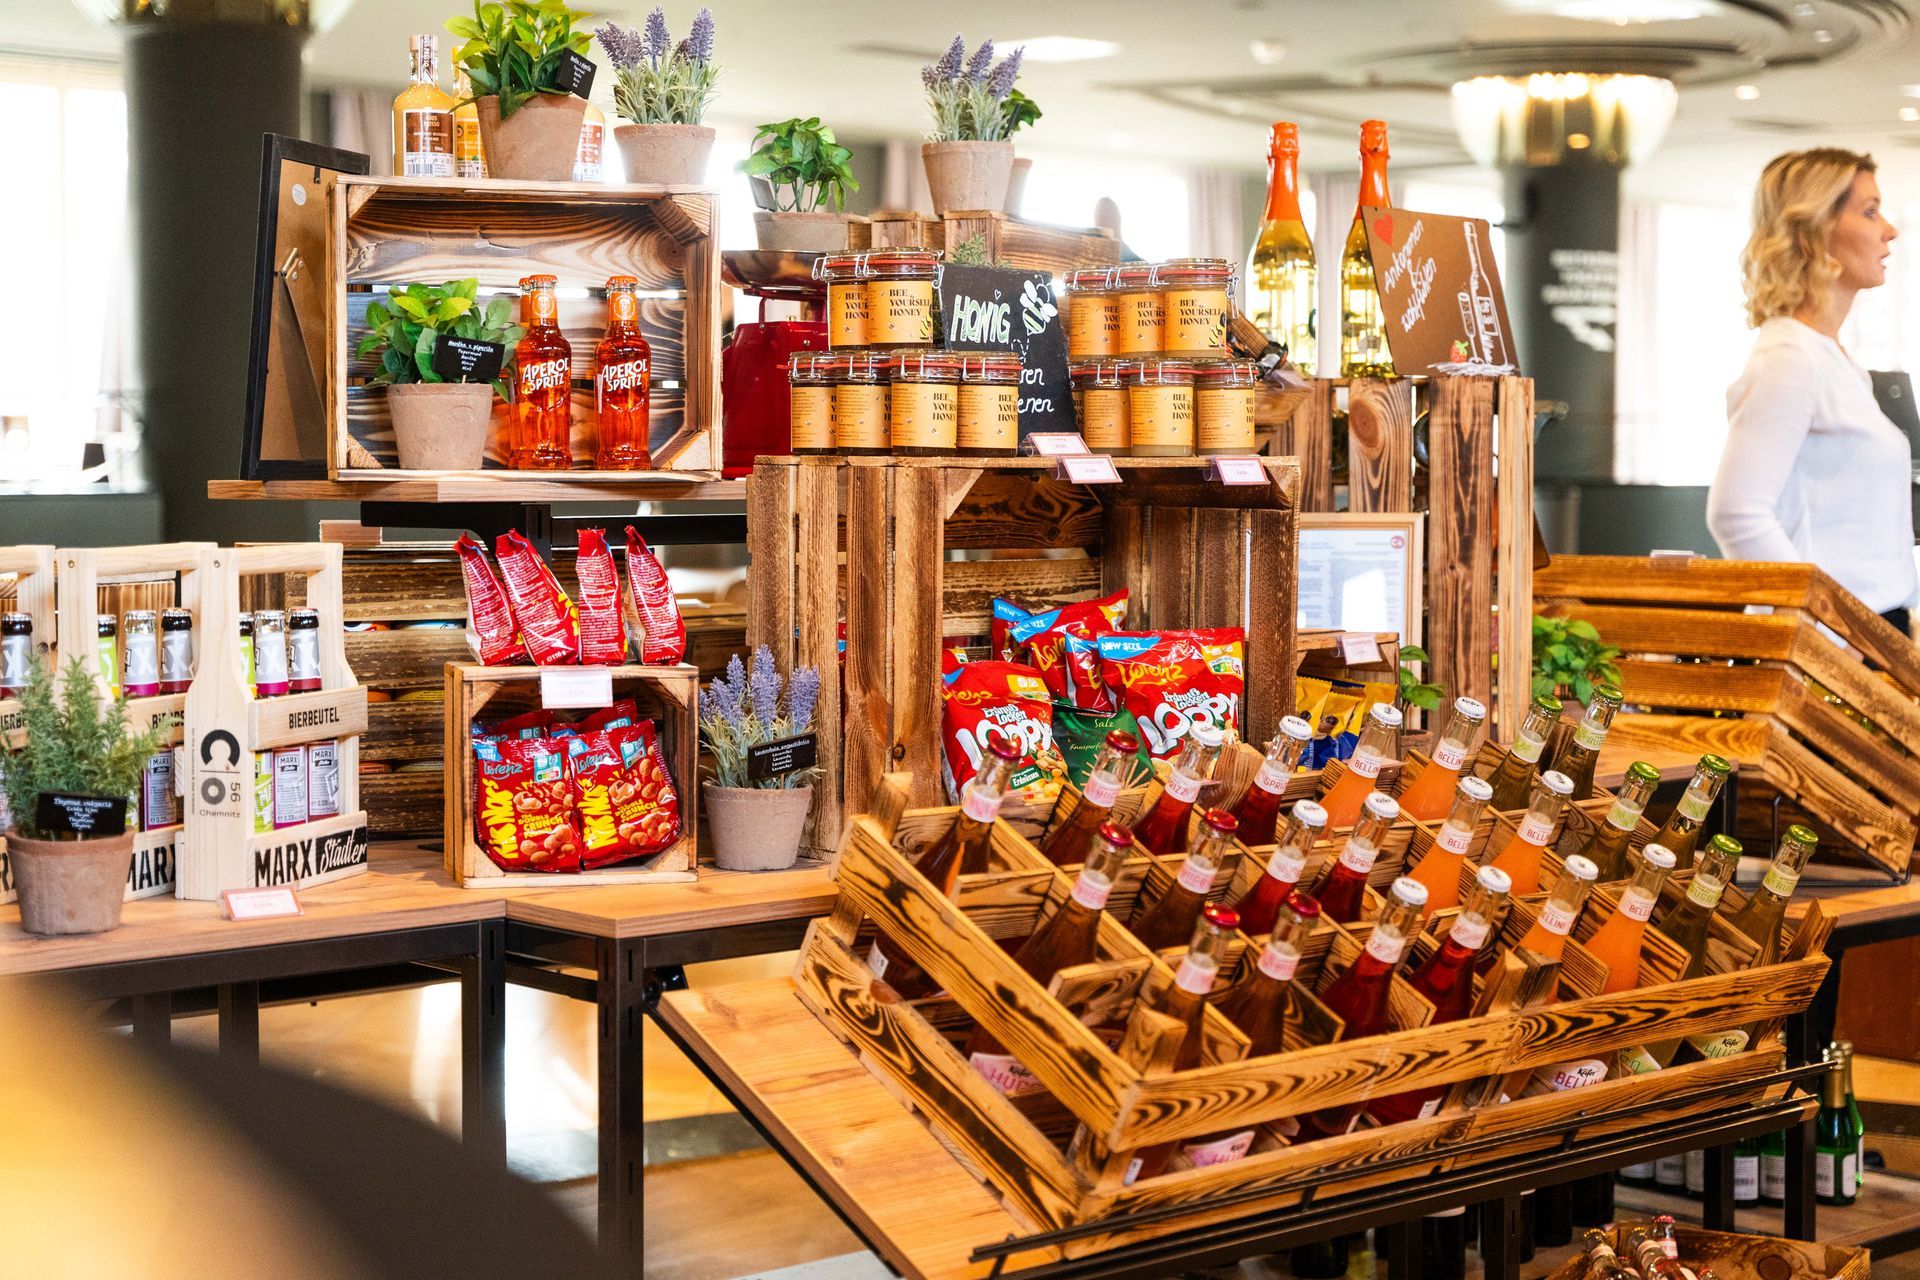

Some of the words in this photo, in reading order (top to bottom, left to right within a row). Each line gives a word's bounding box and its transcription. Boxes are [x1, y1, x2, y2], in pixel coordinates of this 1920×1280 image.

[1384, 219, 1424, 295] Ankommen
[845, 293, 863, 301] BEE
[889, 289, 908, 297] BEE
[1137, 301, 1154, 309] BEE
[1180, 299, 1197, 307] BEE
[889, 309, 921, 317] HONEY
[1137, 310, 1166, 318] YOURS
[950, 294, 1011, 345] HONIG
[1180, 318, 1211, 326] HONEY
[522, 358, 569, 383] APEROL
[601, 359, 648, 383] APEROL
[530, 373, 564, 391] SPRITZ
[607, 373, 643, 392] SPRITZ
[933, 393, 949, 401] BEE
[998, 394, 1013, 402] BEE
[1172, 393, 1187, 401] BEE
[933, 403, 957, 411] YOURS
[998, 404, 1018, 412] YOUR
[998, 414, 1017, 422] HONE
[1101, 642, 1121, 651] NEW
[289, 706, 340, 729] BIERBEUTEL
[1094, 718, 1115, 728] Salz
[314, 750, 332, 758] MARX
[153, 758, 169, 766] MARX
[280, 756, 298, 764] MARX
[575, 753, 610, 774] Lorenz
[484, 760, 523, 775] Lorenz
[199, 809, 241, 818] Chemnitz
[620, 802, 658, 819] CRUNCH
[523, 816, 563, 832] CRUNCH
[255, 838, 312, 887] MARX
[1721, 1038, 1739, 1047] Käfer
[1577, 1066, 1596, 1077] Käfer
